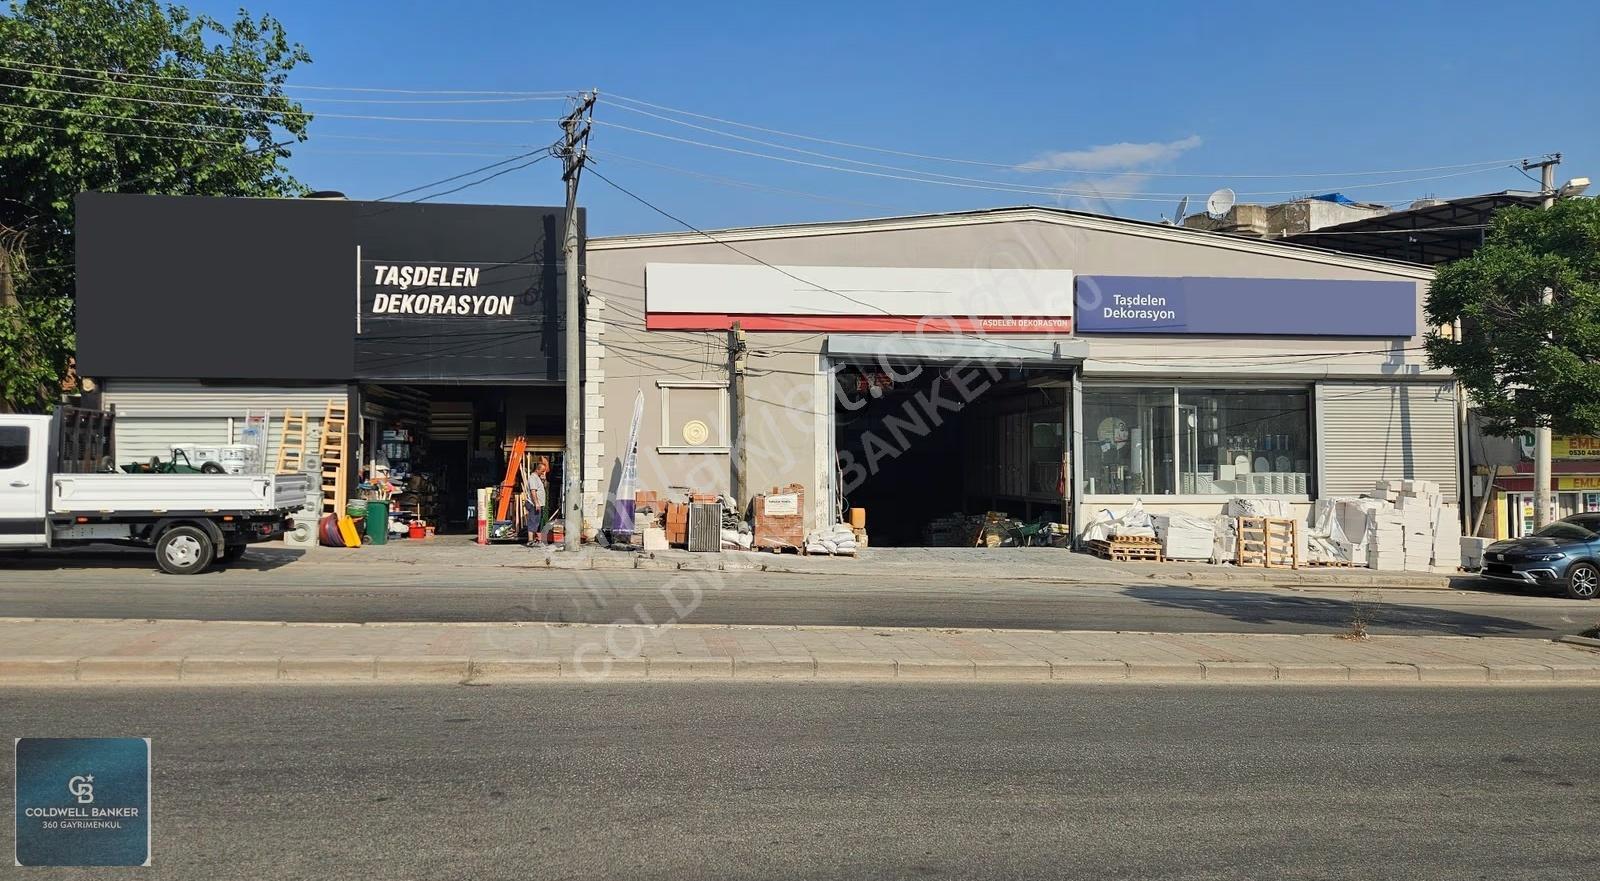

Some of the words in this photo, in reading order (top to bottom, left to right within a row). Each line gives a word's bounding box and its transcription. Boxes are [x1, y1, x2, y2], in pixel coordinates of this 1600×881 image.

[374, 265, 480, 290] TAŞDELEN
[372, 293, 514, 315] DEKORASYON
[1113, 294, 1166, 308] Taşdelen
[1104, 307, 1175, 321] Dekorasyon
[980, 319, 1017, 328] TAŞDELEN
[1019, 319, 1068, 327] DEKORASYON
[1568, 437, 1600, 449] EML
